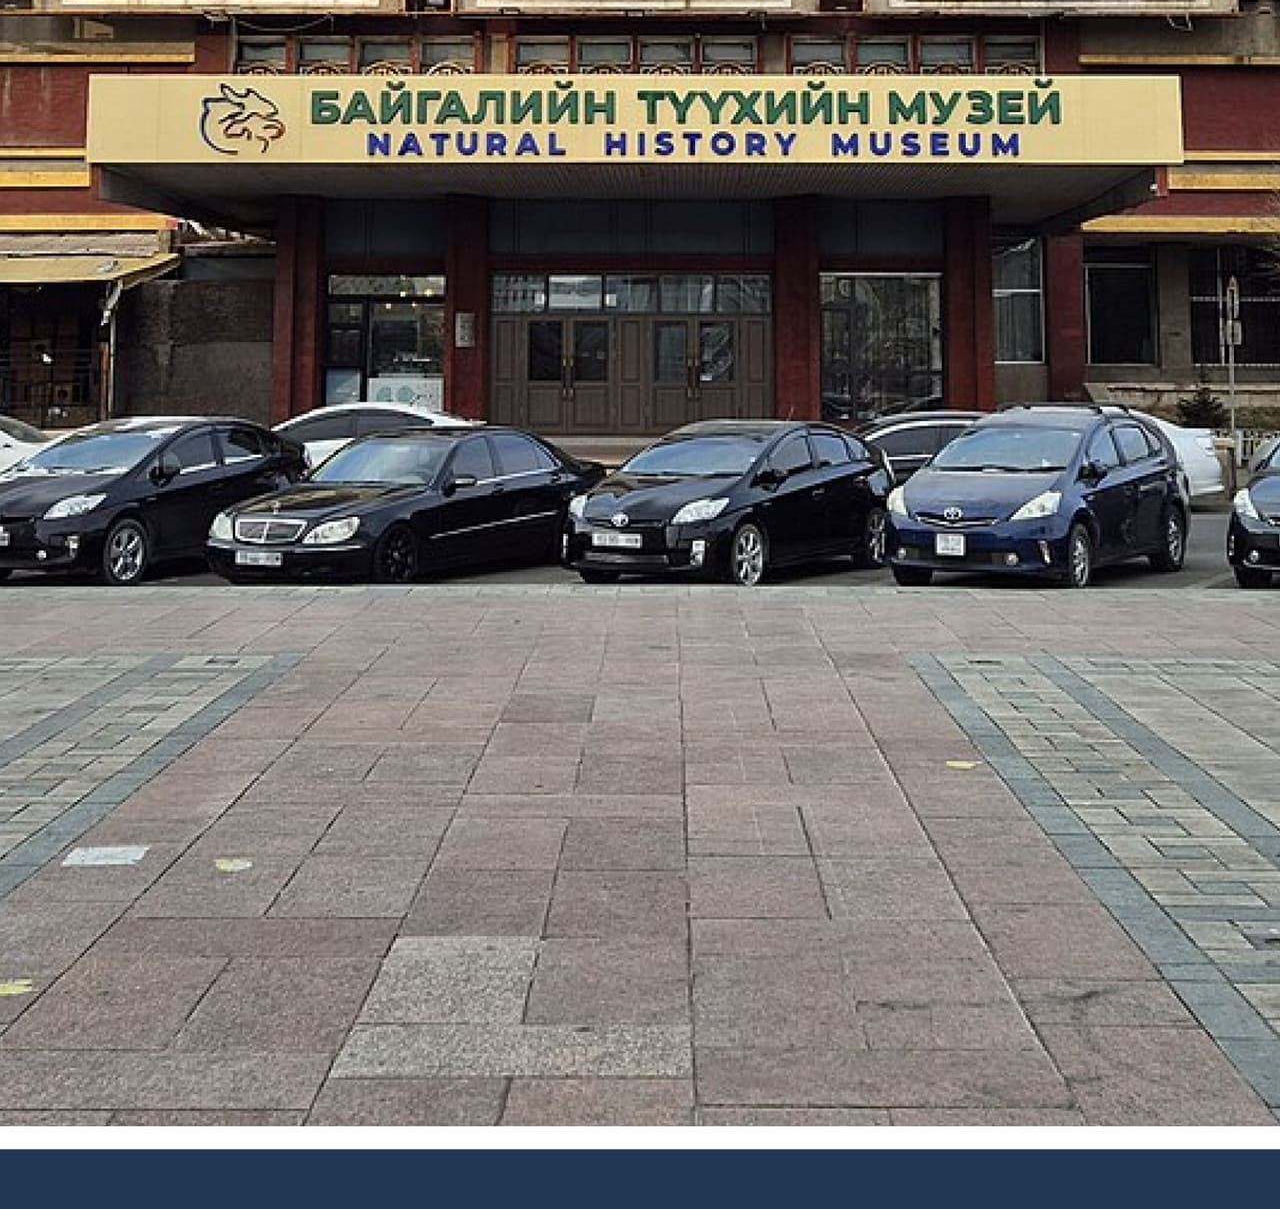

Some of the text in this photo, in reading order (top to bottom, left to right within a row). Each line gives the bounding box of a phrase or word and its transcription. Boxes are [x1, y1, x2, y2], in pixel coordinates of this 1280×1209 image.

[310, 78, 1062, 125] БАЙГАЛИЙН ТҮҮХИЙН МУЗЕЙ
[367, 131, 1021, 157] NATURAL HISTORY MUSEUM
